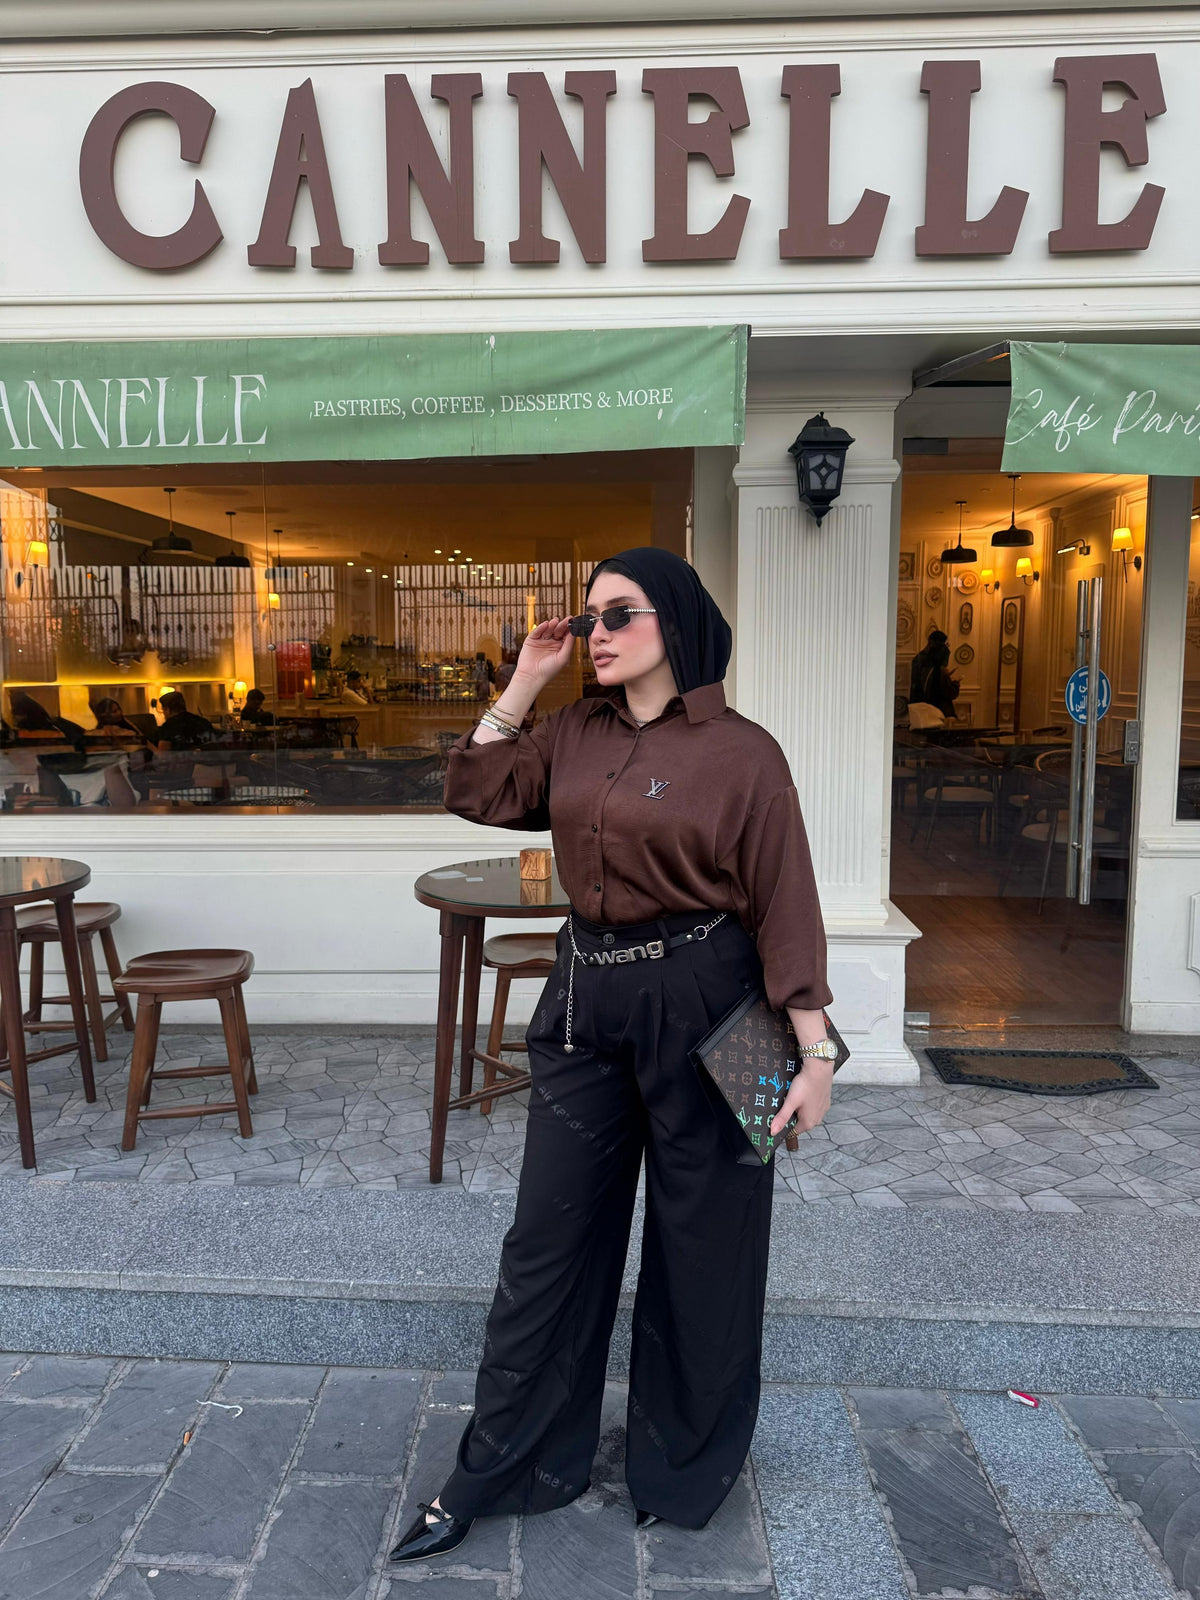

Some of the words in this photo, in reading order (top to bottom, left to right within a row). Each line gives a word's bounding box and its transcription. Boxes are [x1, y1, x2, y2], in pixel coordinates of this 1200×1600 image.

[79, 53, 1168, 269] CANNELLE
[313, 398, 406, 420] PASTRIES,
[411, 396, 485, 415] COFFEE
[500, 392, 592, 412] DESSERTS
[597, 390, 612, 408] &
[616, 388, 673, 408] MORE
[1004, 388, 1102, 452] Café
[1113, 389, 1200, 444] Pari
[594, 940, 665, 965] wang
